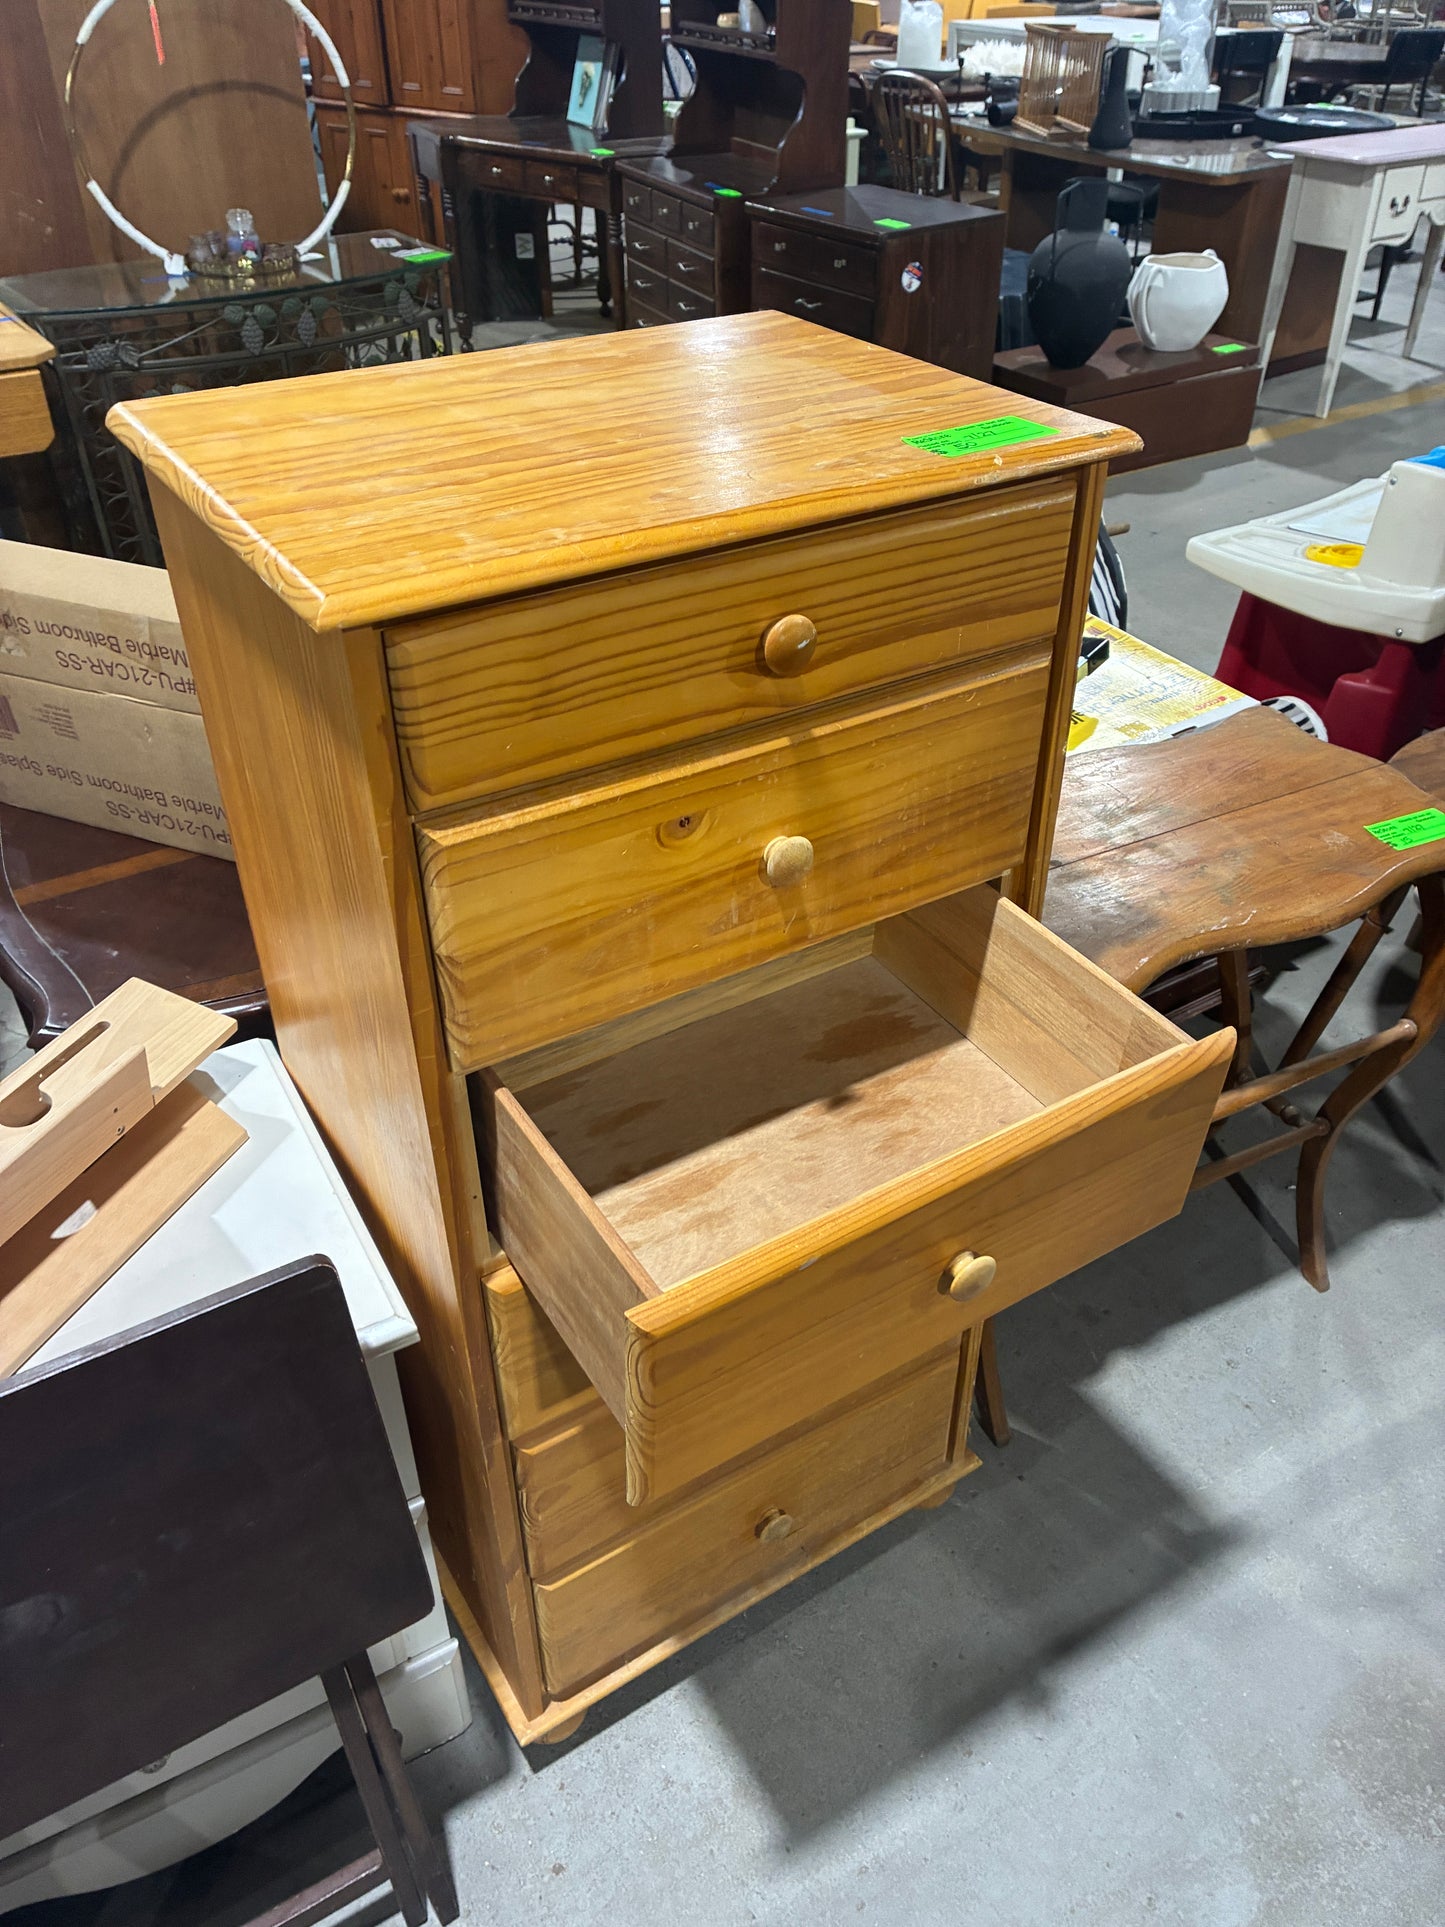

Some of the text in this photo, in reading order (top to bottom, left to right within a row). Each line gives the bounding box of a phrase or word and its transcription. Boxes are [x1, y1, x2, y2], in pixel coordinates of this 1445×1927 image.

[0, 612, 189, 668] Marble Bathroom Sid
[55, 650, 197, 695] #PU-21CAR-SS
[47, 764, 83, 787] Side
[86, 774, 168, 807] Bathroom
[171, 794, 227, 820] Marble
